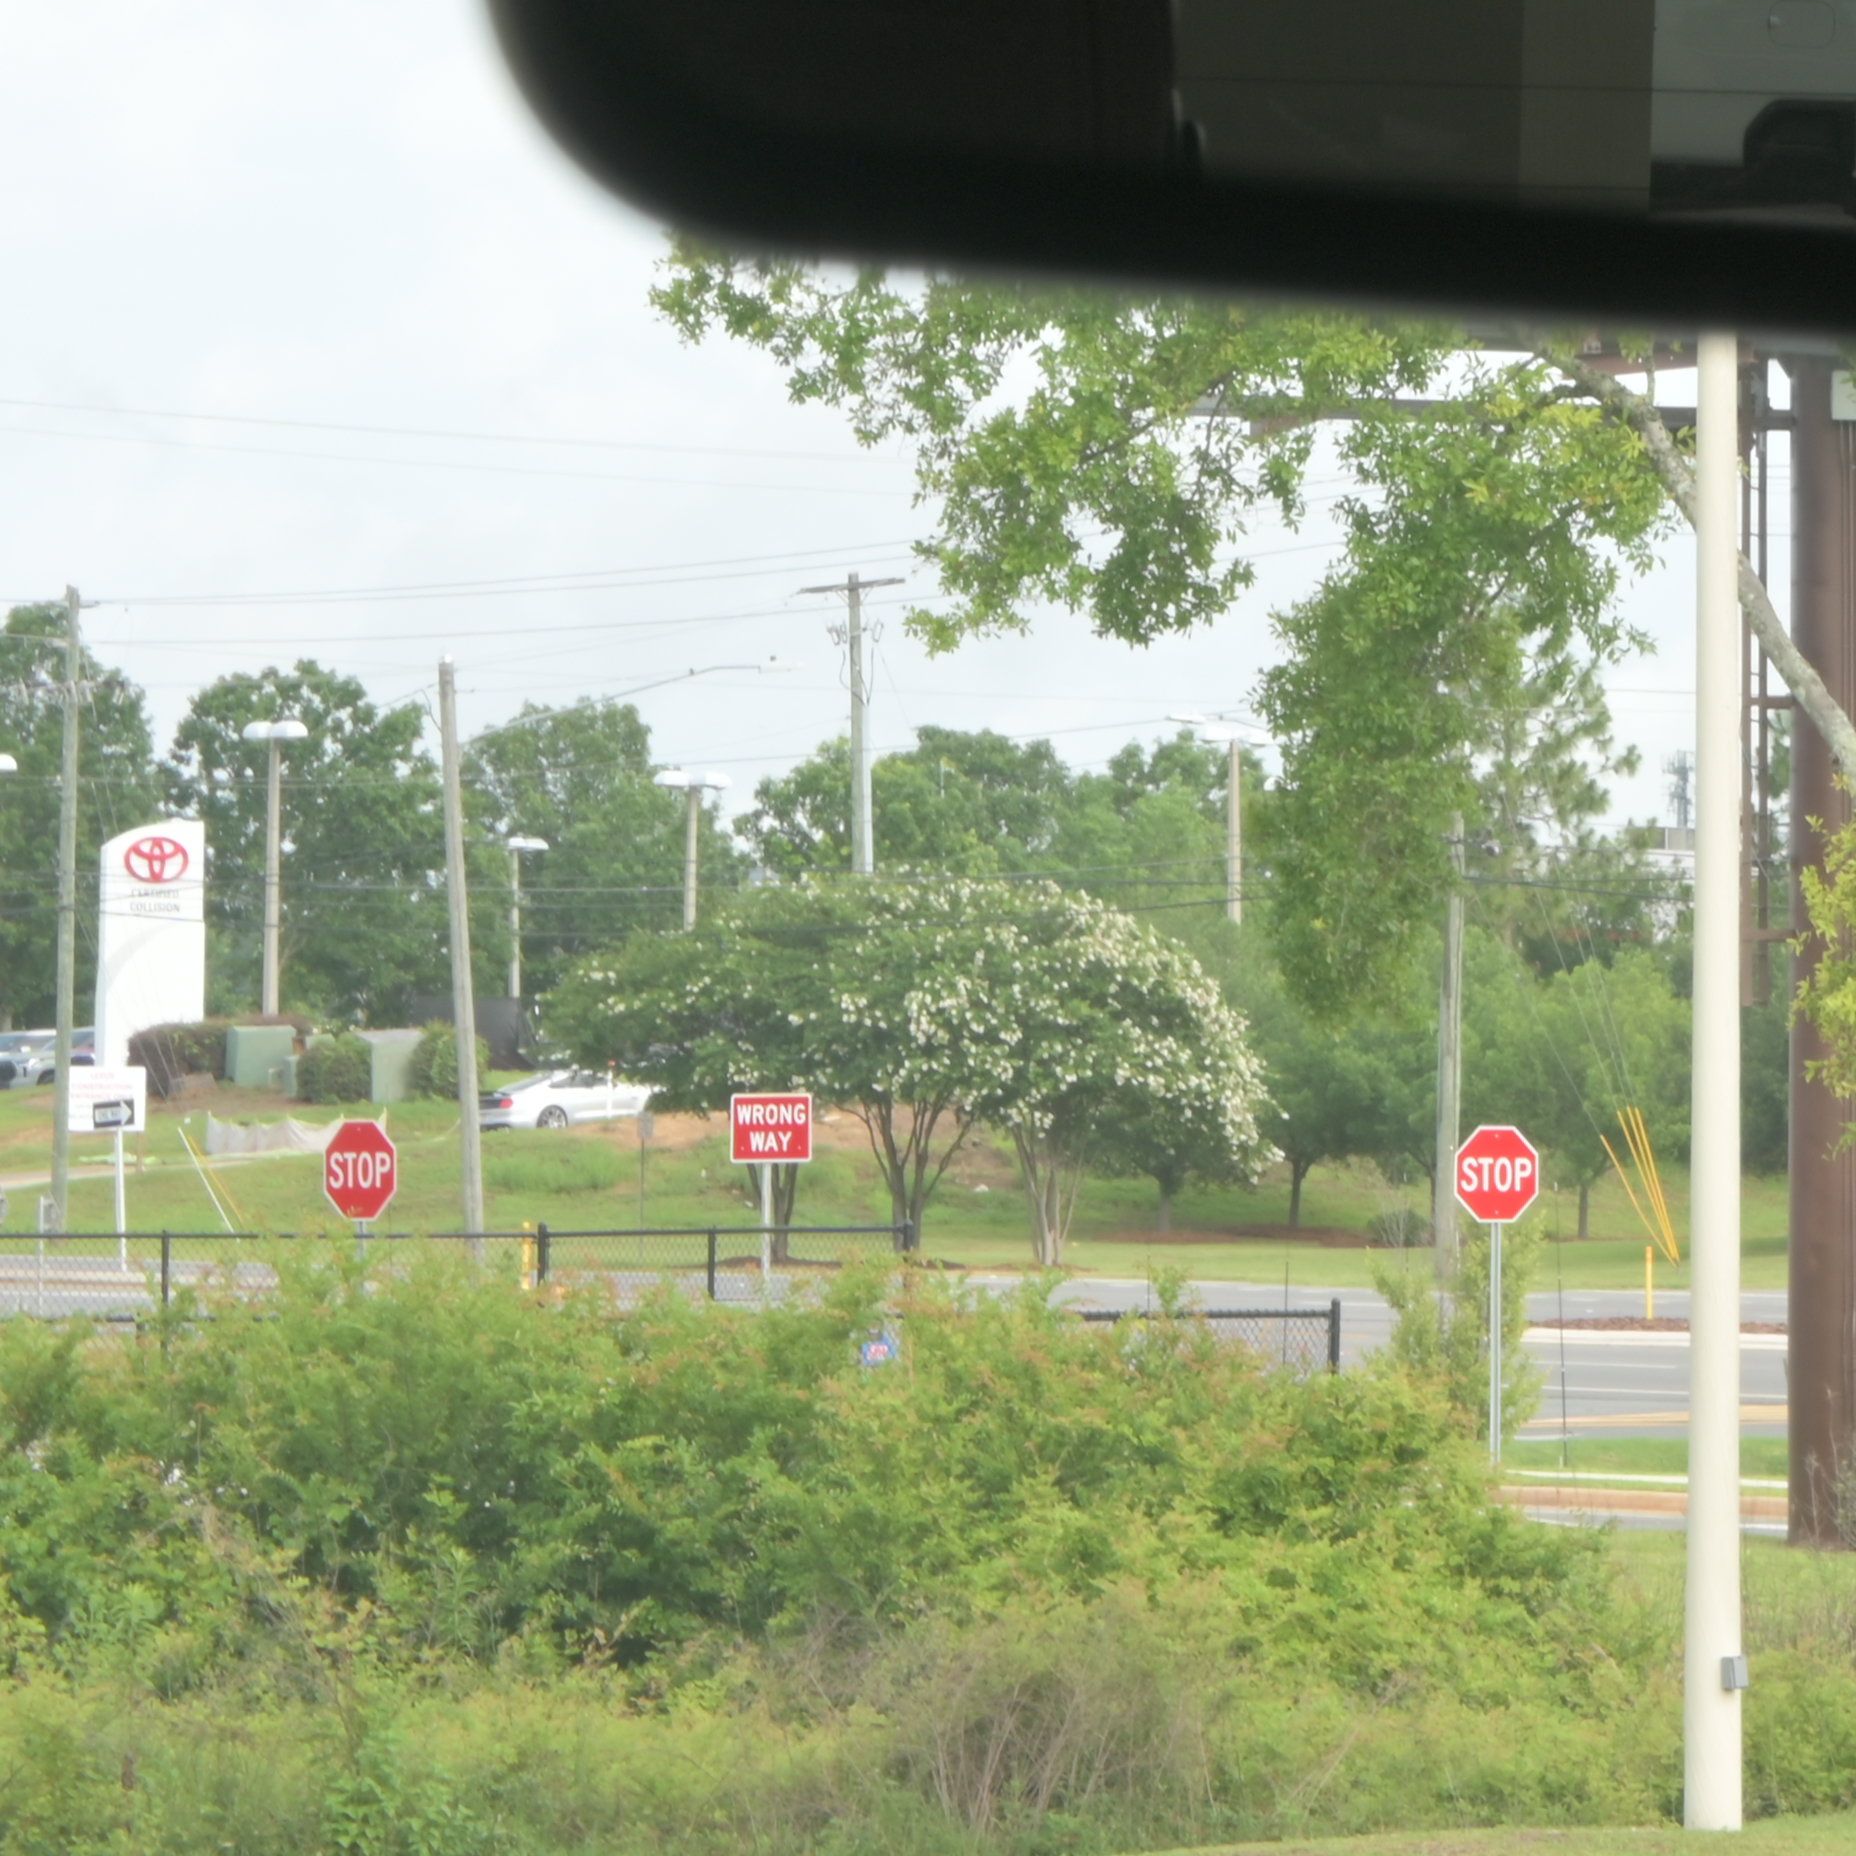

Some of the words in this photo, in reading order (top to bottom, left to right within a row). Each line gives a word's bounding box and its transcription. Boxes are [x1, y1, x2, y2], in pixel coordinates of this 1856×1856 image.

[130, 902, 180, 912] COLLISION
[737, 1104, 806, 1125] WRONG
[749, 1131, 792, 1152] WAY
[329, 1151, 391, 1189] STOP
[1461, 1156, 1532, 1192] STOP
